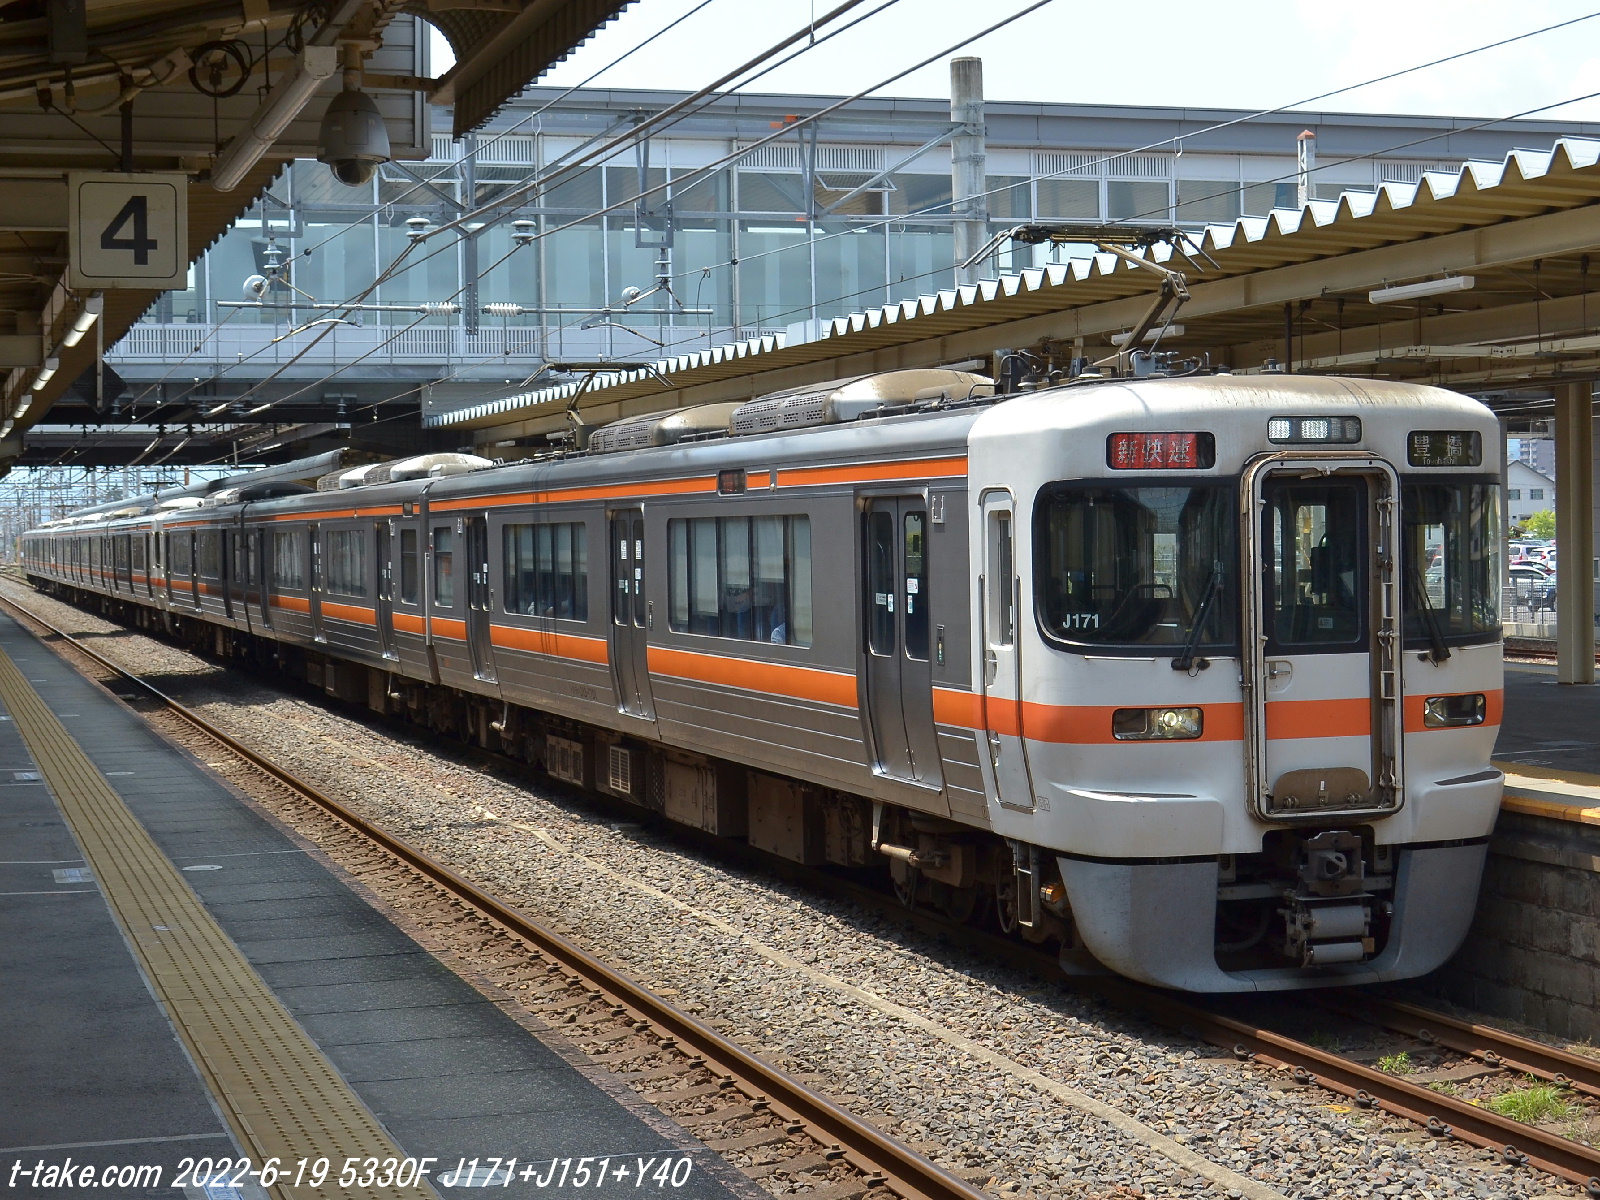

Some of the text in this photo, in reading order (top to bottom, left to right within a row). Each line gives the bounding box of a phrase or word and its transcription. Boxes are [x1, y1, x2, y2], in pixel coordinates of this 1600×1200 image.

[100, 195, 158, 266] 4
[1117, 438, 1192, 463] 新快速
[1062, 613, 1099, 629] J171
